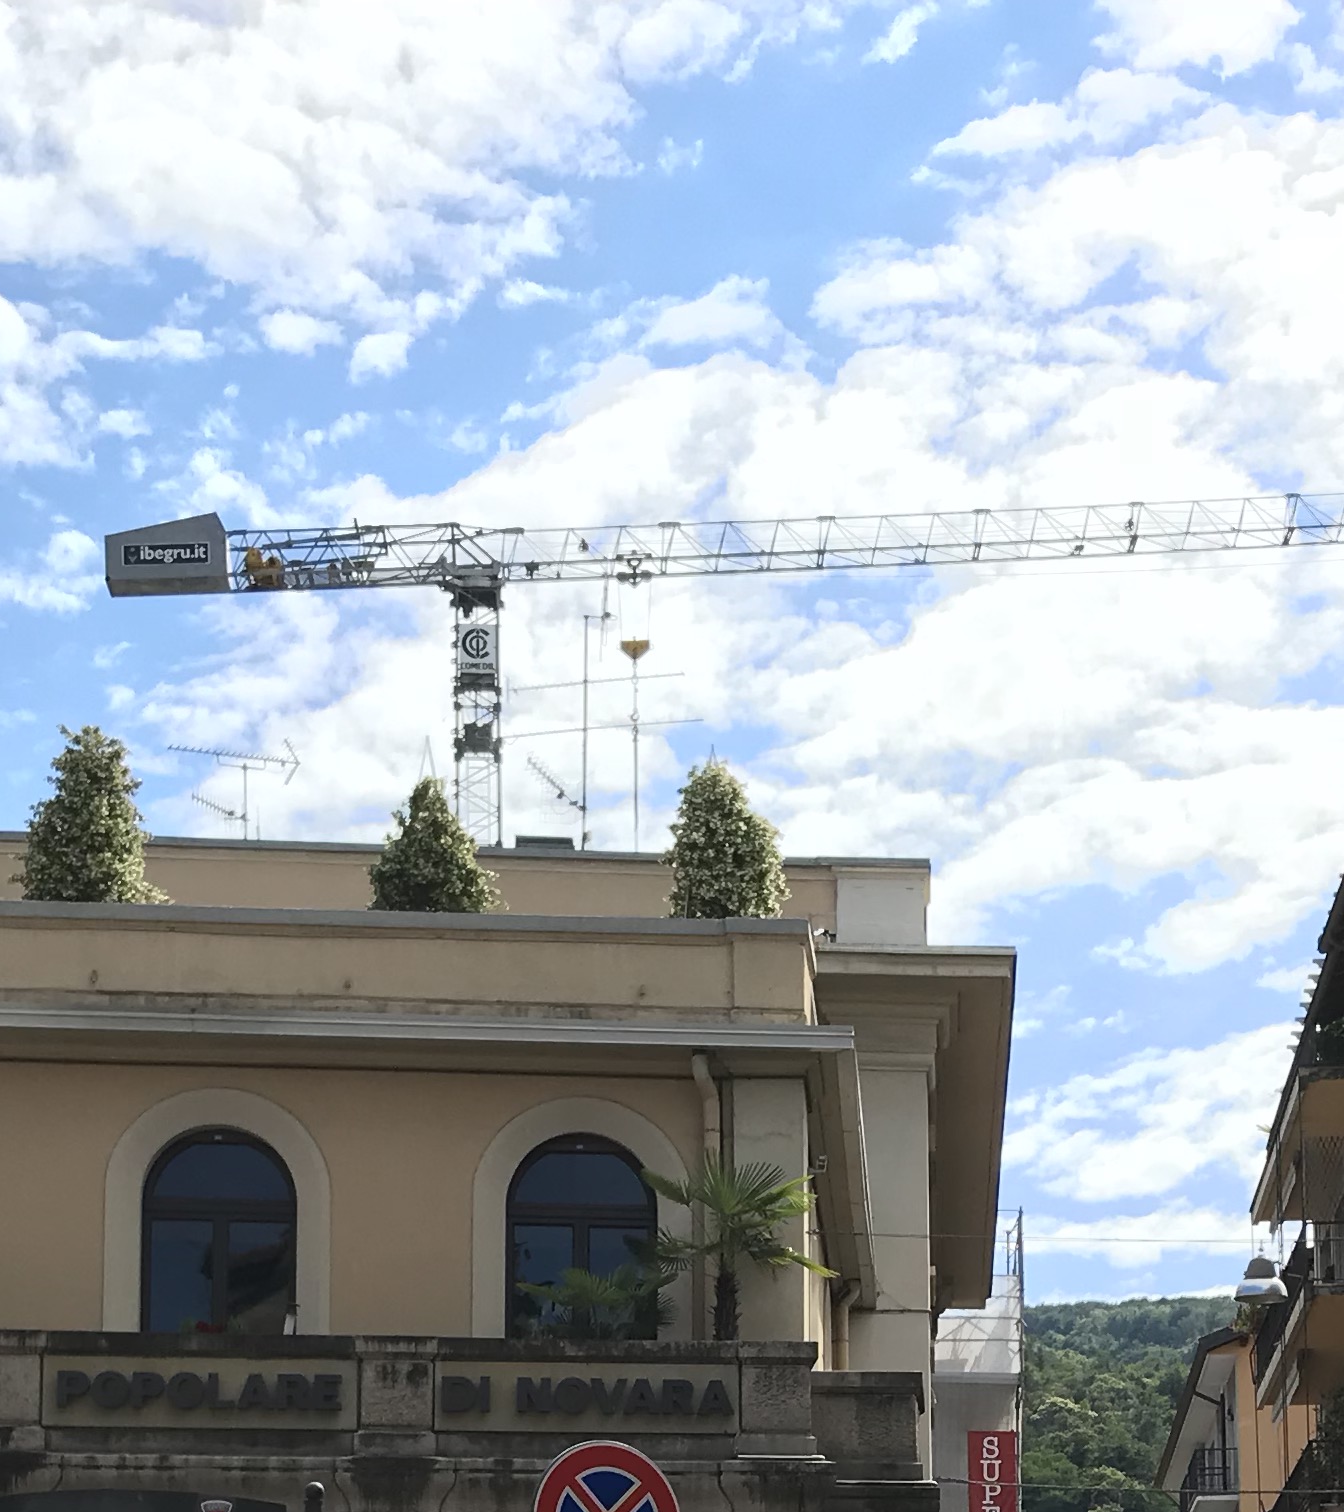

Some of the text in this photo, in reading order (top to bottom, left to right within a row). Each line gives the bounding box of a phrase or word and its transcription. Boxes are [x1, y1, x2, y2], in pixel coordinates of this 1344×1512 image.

[140, 544, 207, 563] ibegru.it
[57, 1371, 342, 1411] POPOLARE
[441, 1376, 490, 1413] DI
[517, 1377, 735, 1416] NOVARA
